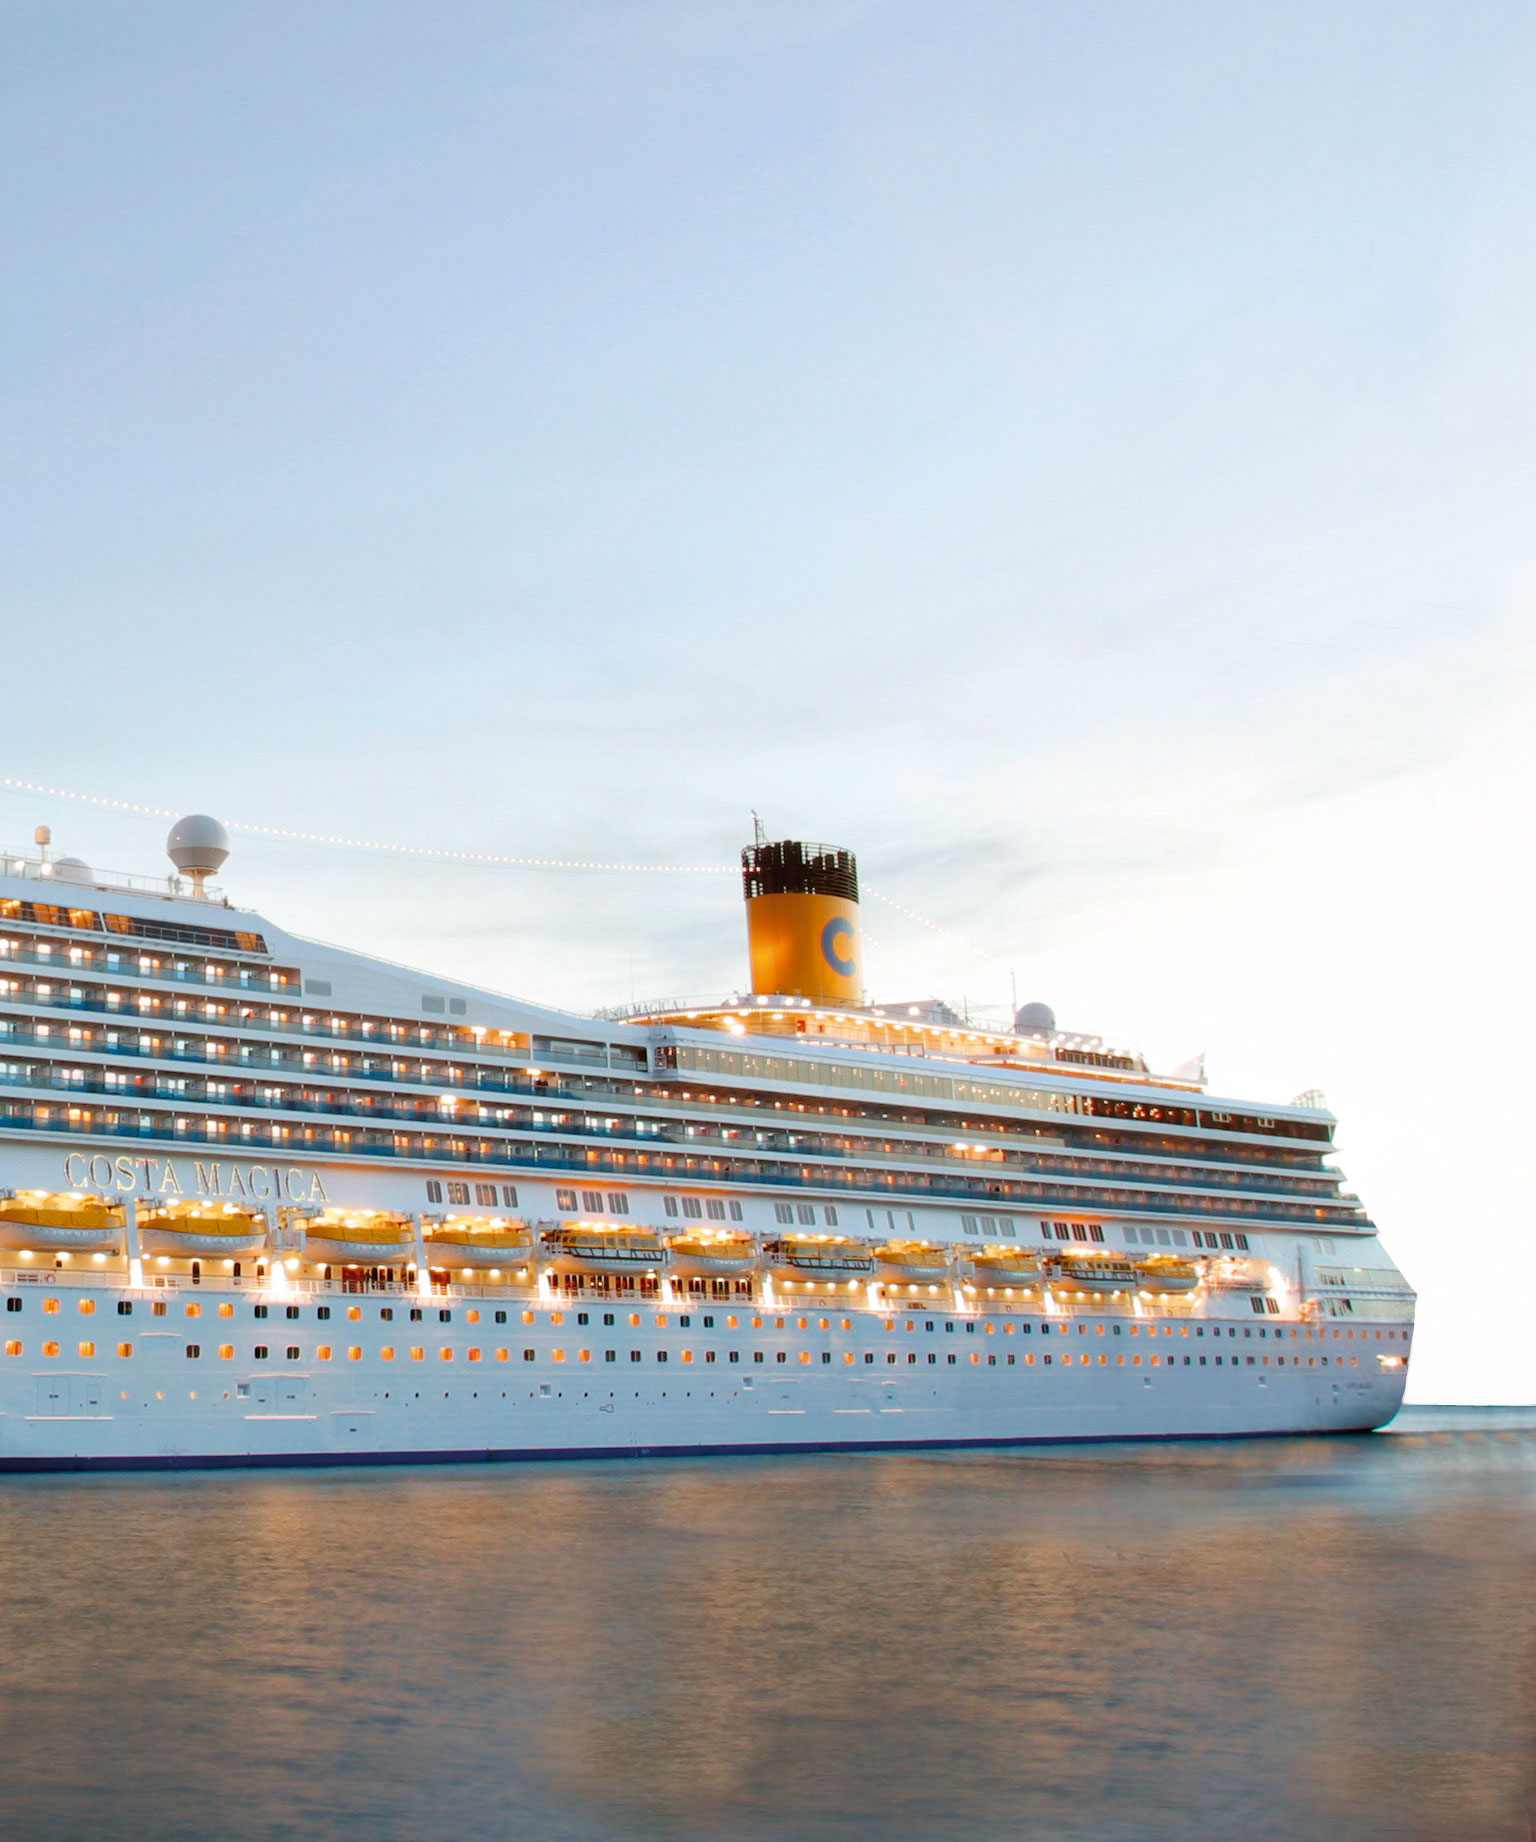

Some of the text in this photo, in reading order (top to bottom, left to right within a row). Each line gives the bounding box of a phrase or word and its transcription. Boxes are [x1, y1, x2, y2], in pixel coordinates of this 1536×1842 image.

[821, 917, 856, 977] C
[63, 1152, 330, 1203] COSTA MAGICA
